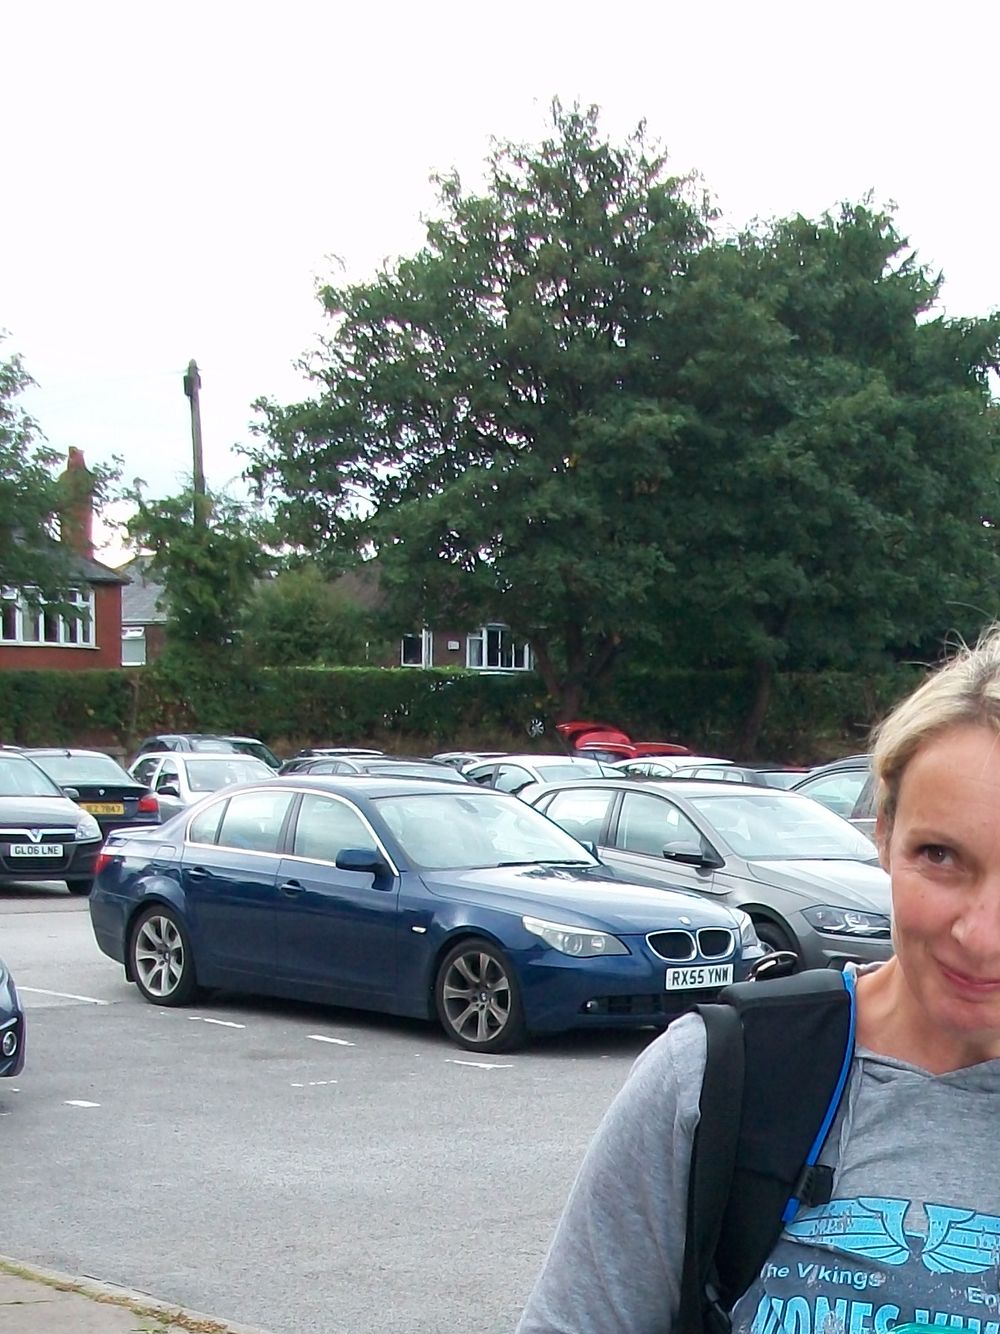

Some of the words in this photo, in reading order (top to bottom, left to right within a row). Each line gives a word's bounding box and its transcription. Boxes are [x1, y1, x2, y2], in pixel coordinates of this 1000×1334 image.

[14, 845, 40, 855] GL06
[41, 845, 60, 855] LNE
[672, 969, 705, 987] RX55
[708, 966, 729, 984] YNW
[797, 1262, 886, 1290] Vikings
